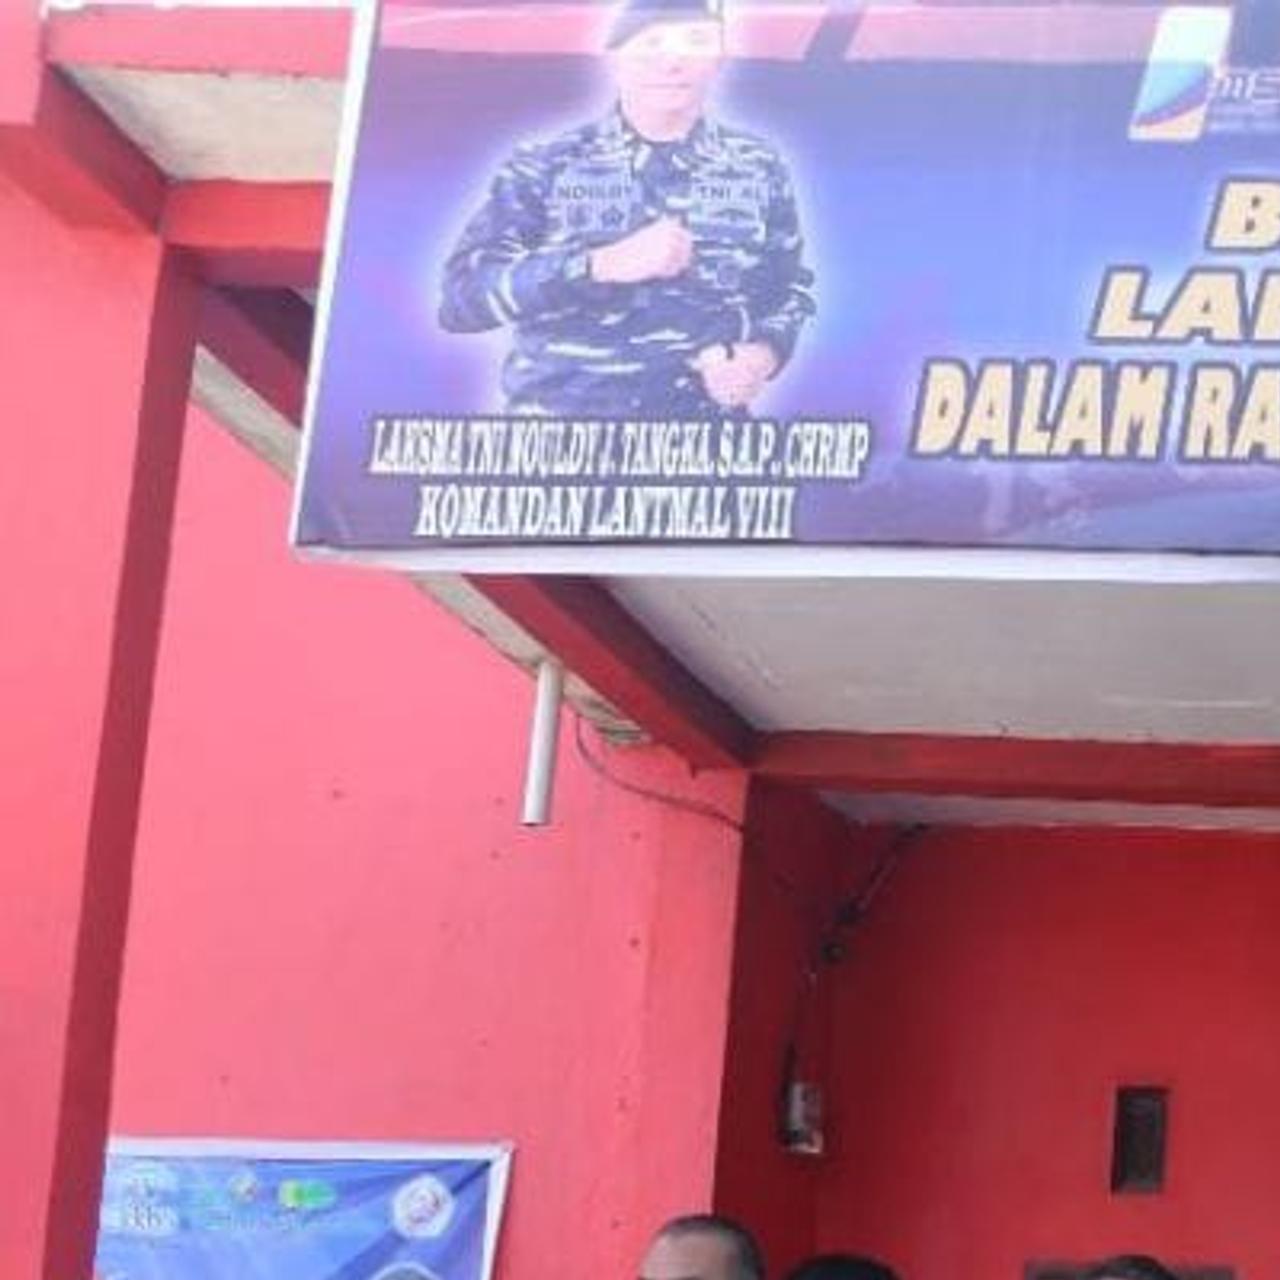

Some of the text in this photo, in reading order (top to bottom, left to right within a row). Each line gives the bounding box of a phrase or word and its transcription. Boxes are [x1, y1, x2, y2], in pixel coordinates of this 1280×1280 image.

[913, 360, 1172, 460] DALAM
[467, 420, 506, 476] TNI
[413, 483, 798, 539] KOMANDAN LANTMAL VIII
